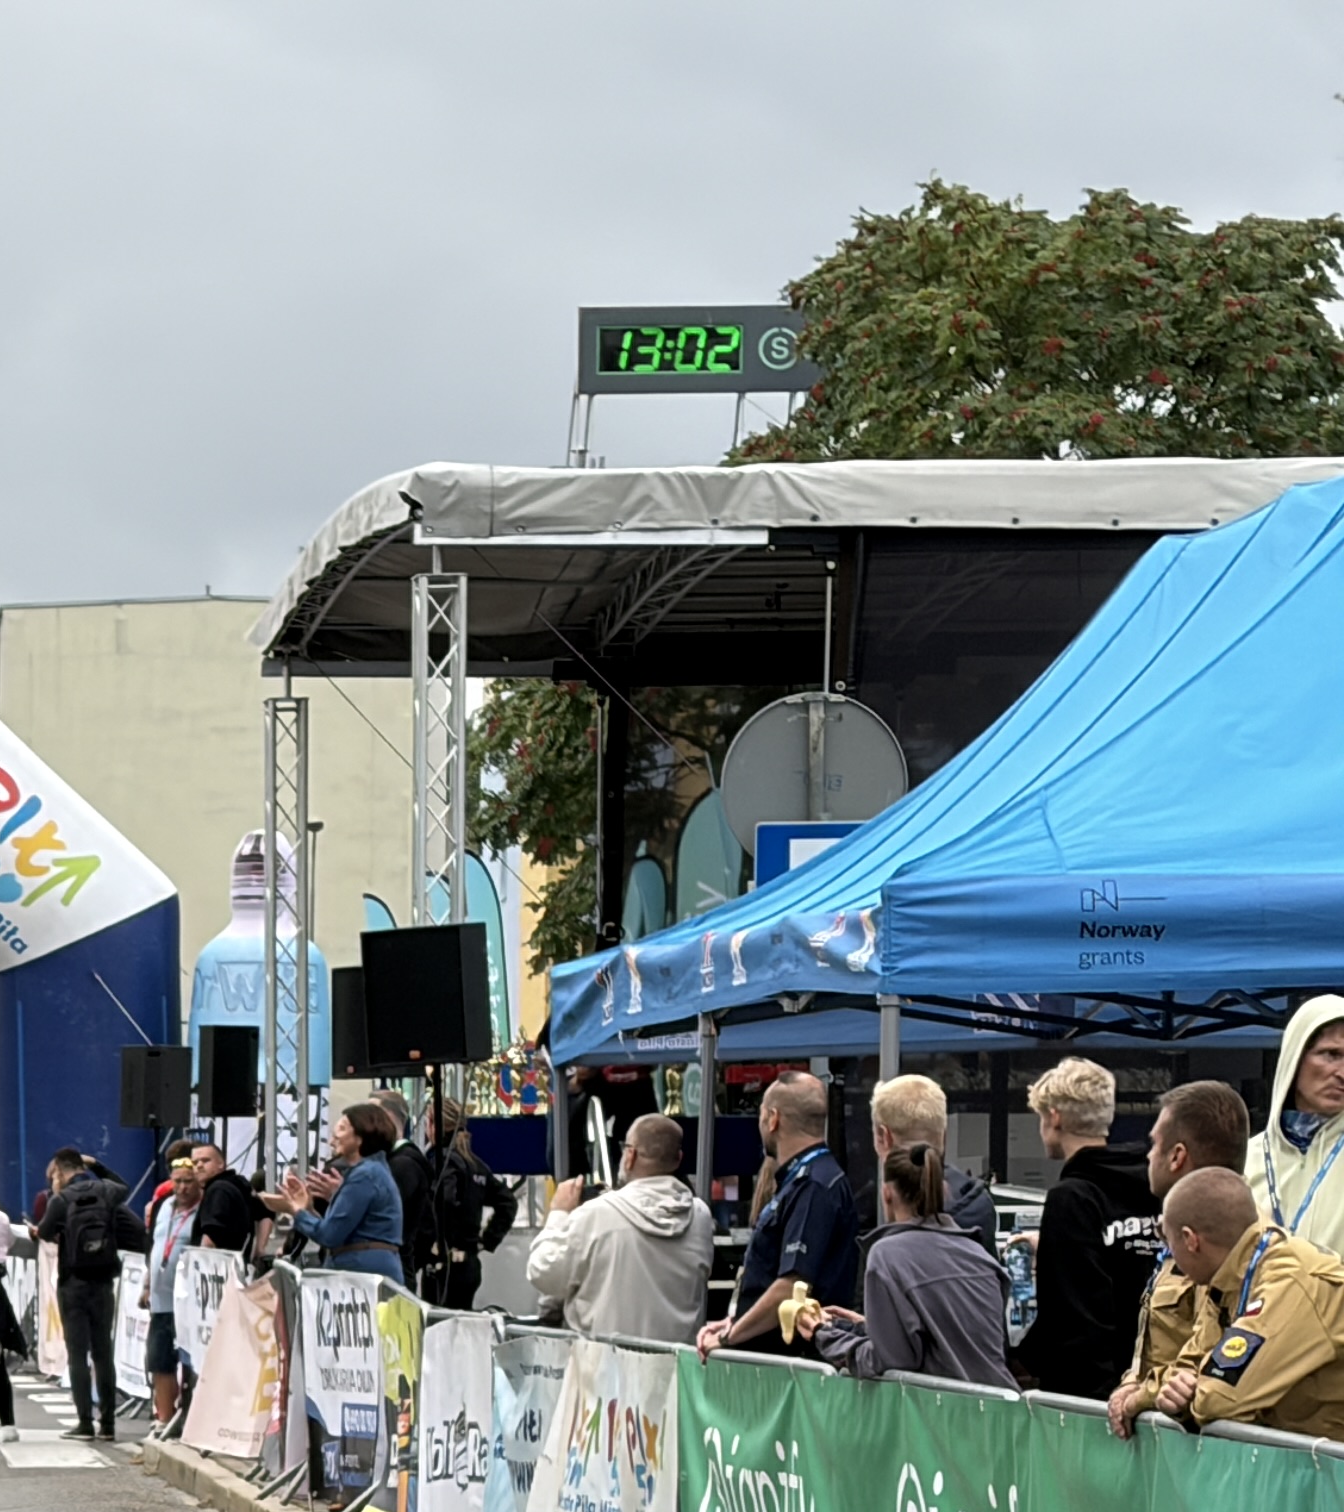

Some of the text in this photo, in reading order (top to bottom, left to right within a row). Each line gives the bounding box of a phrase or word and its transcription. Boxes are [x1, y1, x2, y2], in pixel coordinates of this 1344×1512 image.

[618, 327, 740, 372] 13:02
[1079, 921, 1166, 942] Norway
[1078, 949, 1145, 970] grants
